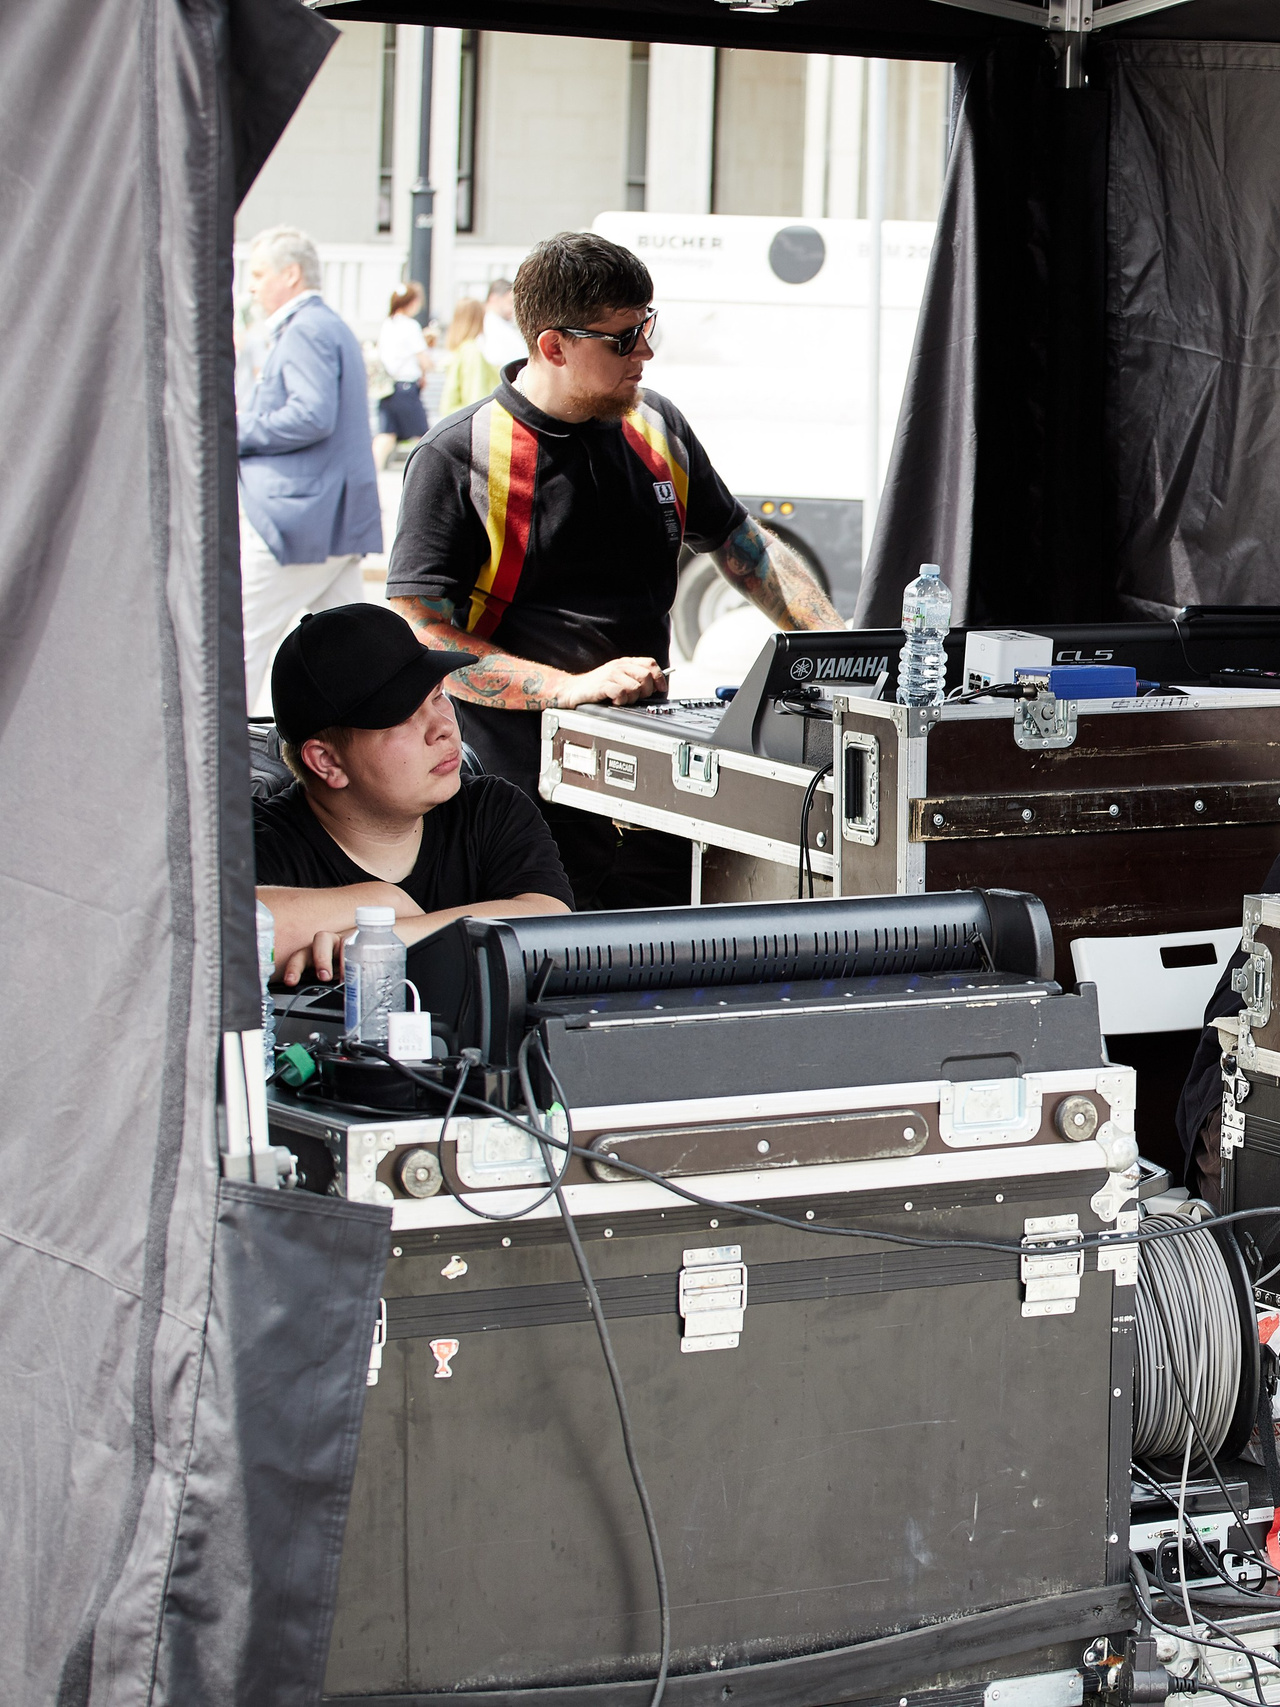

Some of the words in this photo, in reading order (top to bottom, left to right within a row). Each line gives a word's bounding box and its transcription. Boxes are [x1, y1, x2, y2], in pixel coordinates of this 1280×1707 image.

[637, 234, 723, 249] BUCHER
[1056, 650, 1114, 662] CL5
[815, 656, 889, 679] YAMAHA
